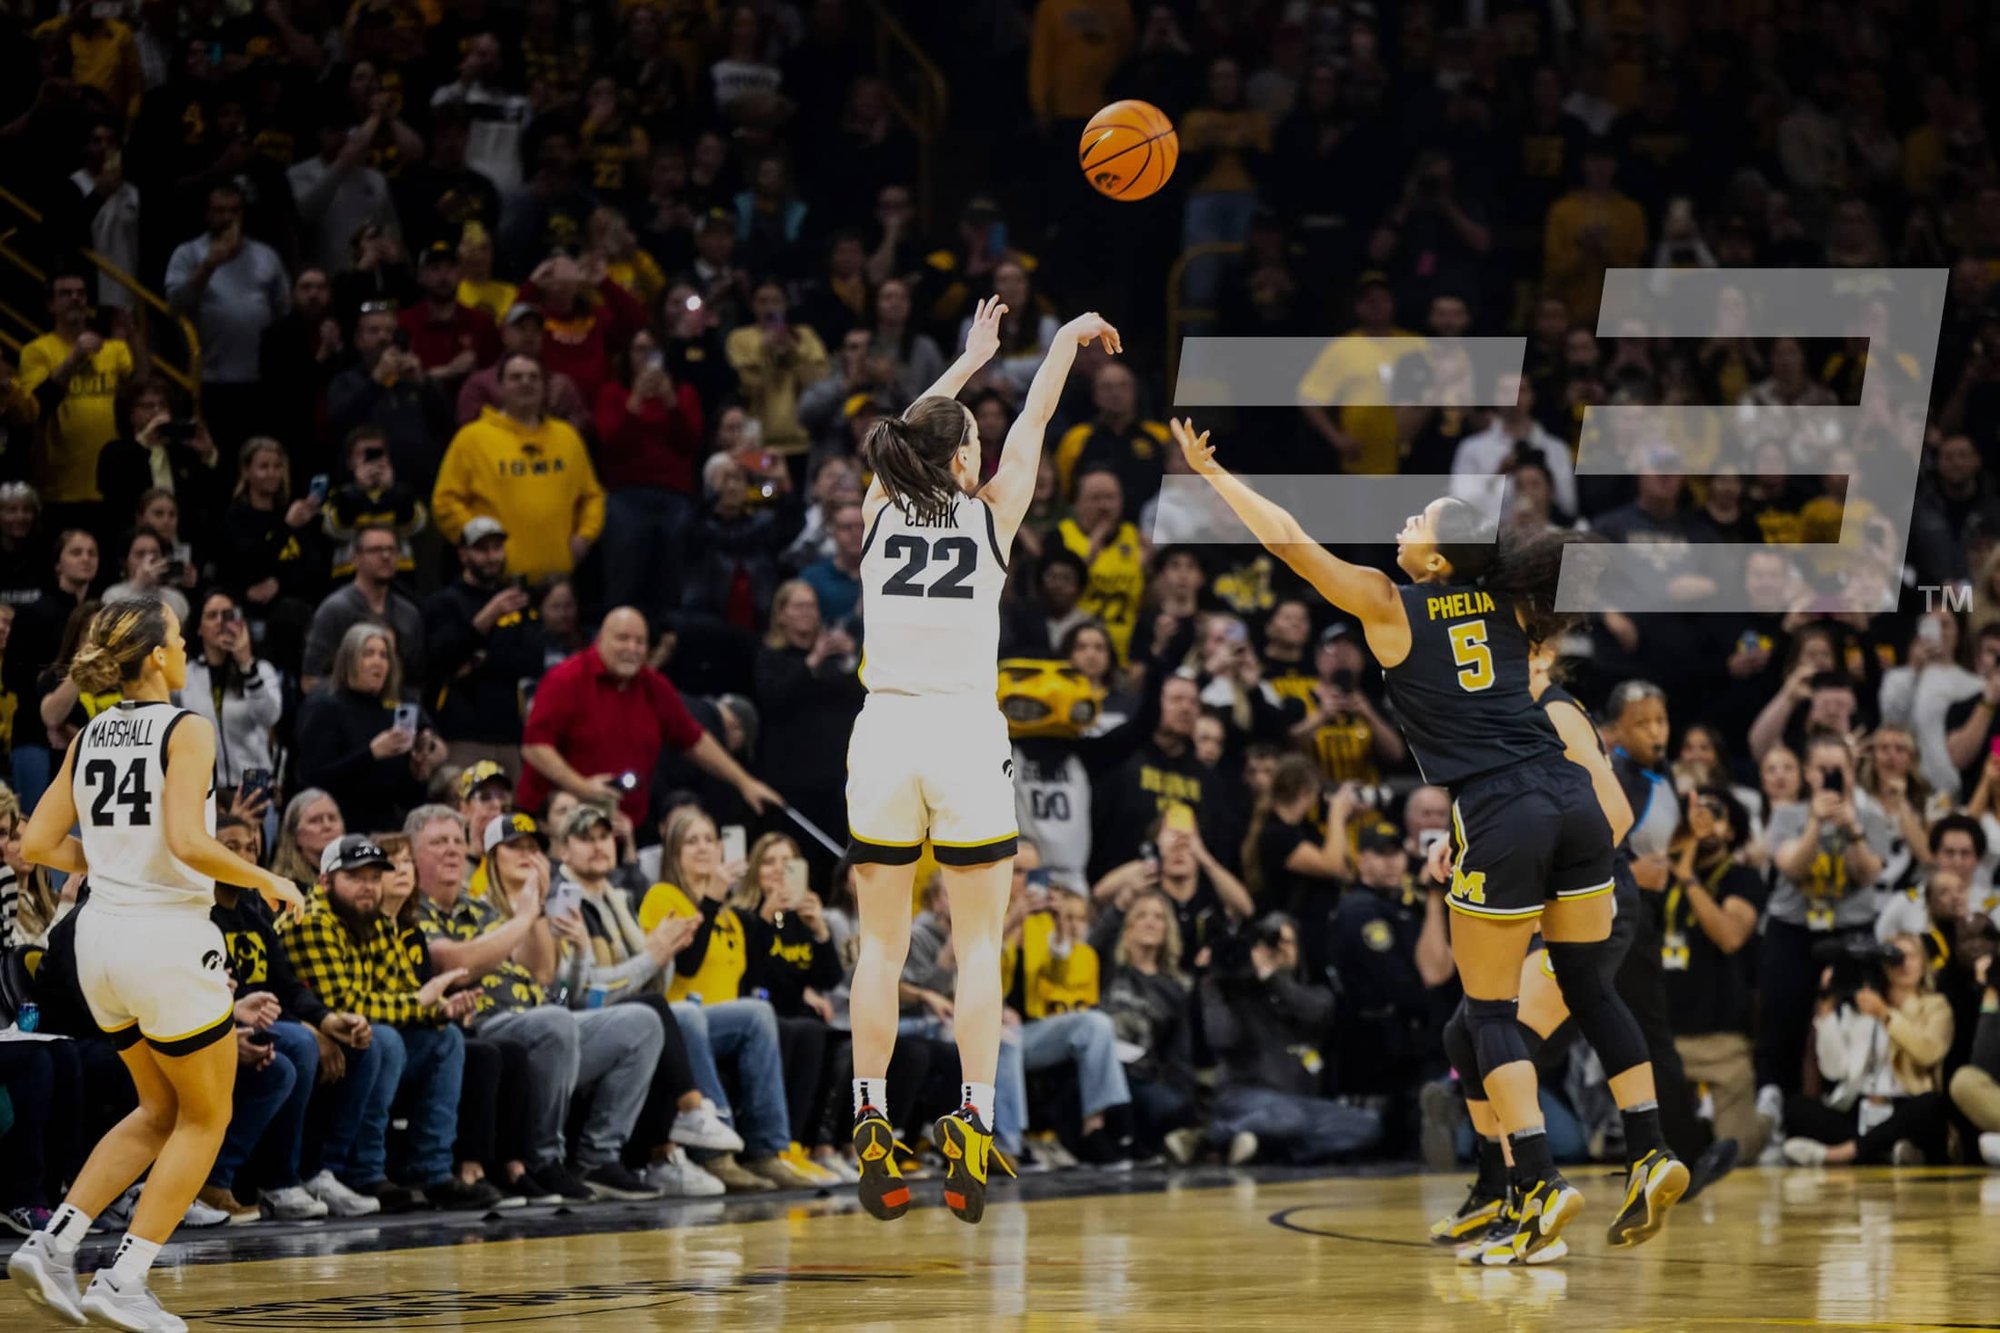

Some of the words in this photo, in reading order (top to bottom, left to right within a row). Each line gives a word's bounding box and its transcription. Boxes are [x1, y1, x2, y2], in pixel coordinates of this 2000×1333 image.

[881, 534, 978, 599] 22
[1426, 592, 1495, 620] PHELIA
[1446, 618, 1496, 694] 5
[88, 718, 154, 748] MARSHALL
[84, 757, 152, 827] 24
[1451, 865, 1486, 905] M
